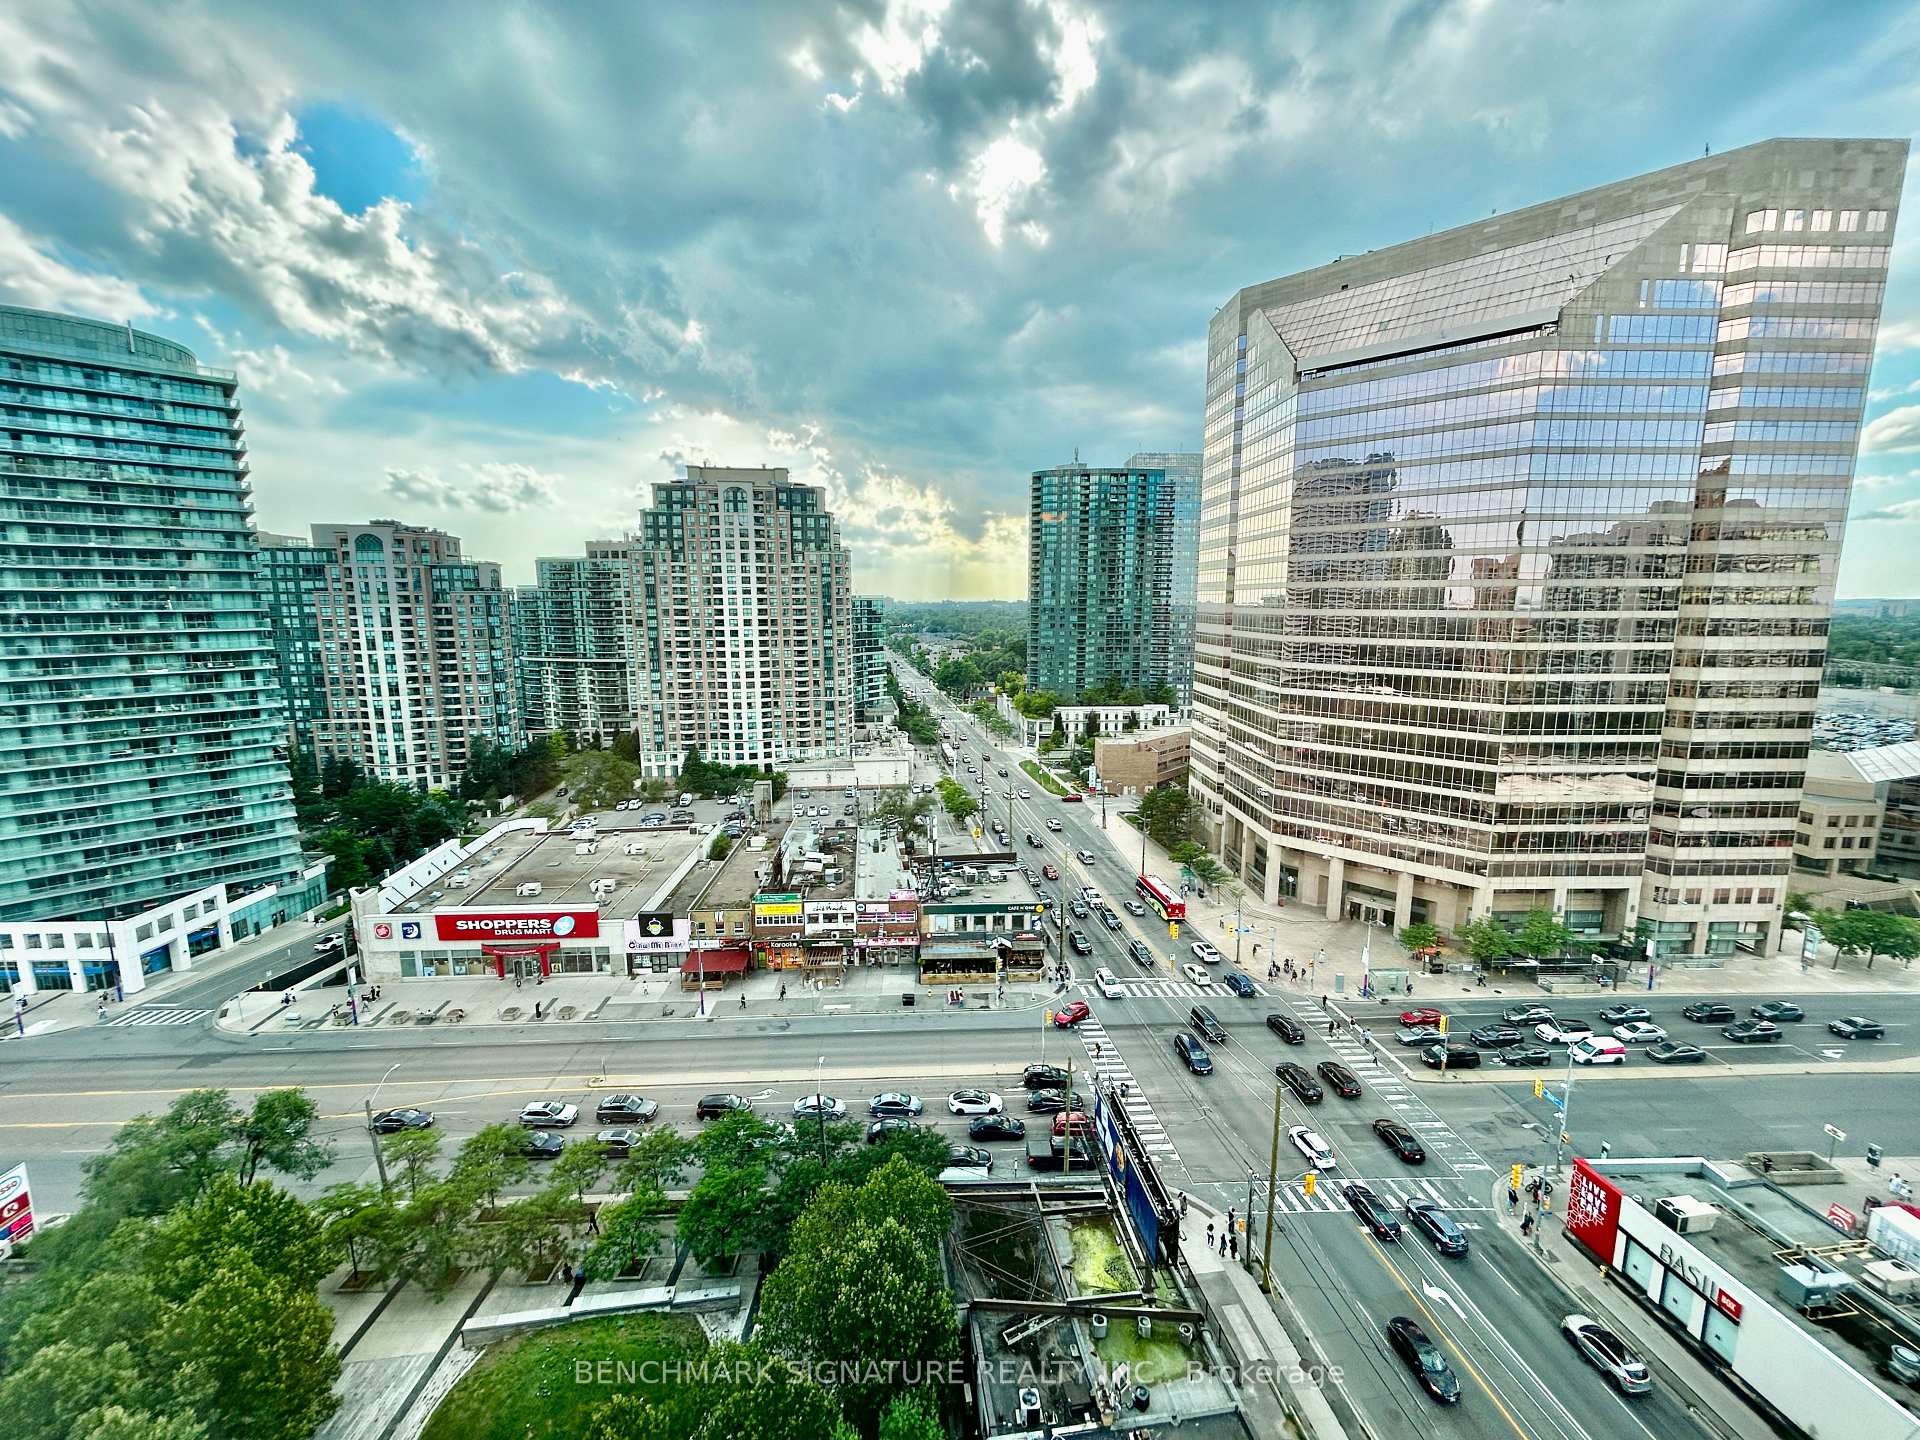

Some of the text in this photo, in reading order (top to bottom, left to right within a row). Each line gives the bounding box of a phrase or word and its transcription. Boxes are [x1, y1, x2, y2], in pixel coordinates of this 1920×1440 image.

[456, 918, 551, 930] SHOPPERS
[524, 928, 551, 936] MART
[1582, 1176, 1607, 1202] LIVE
[1660, 1243, 1737, 1312] BASIL BOX
